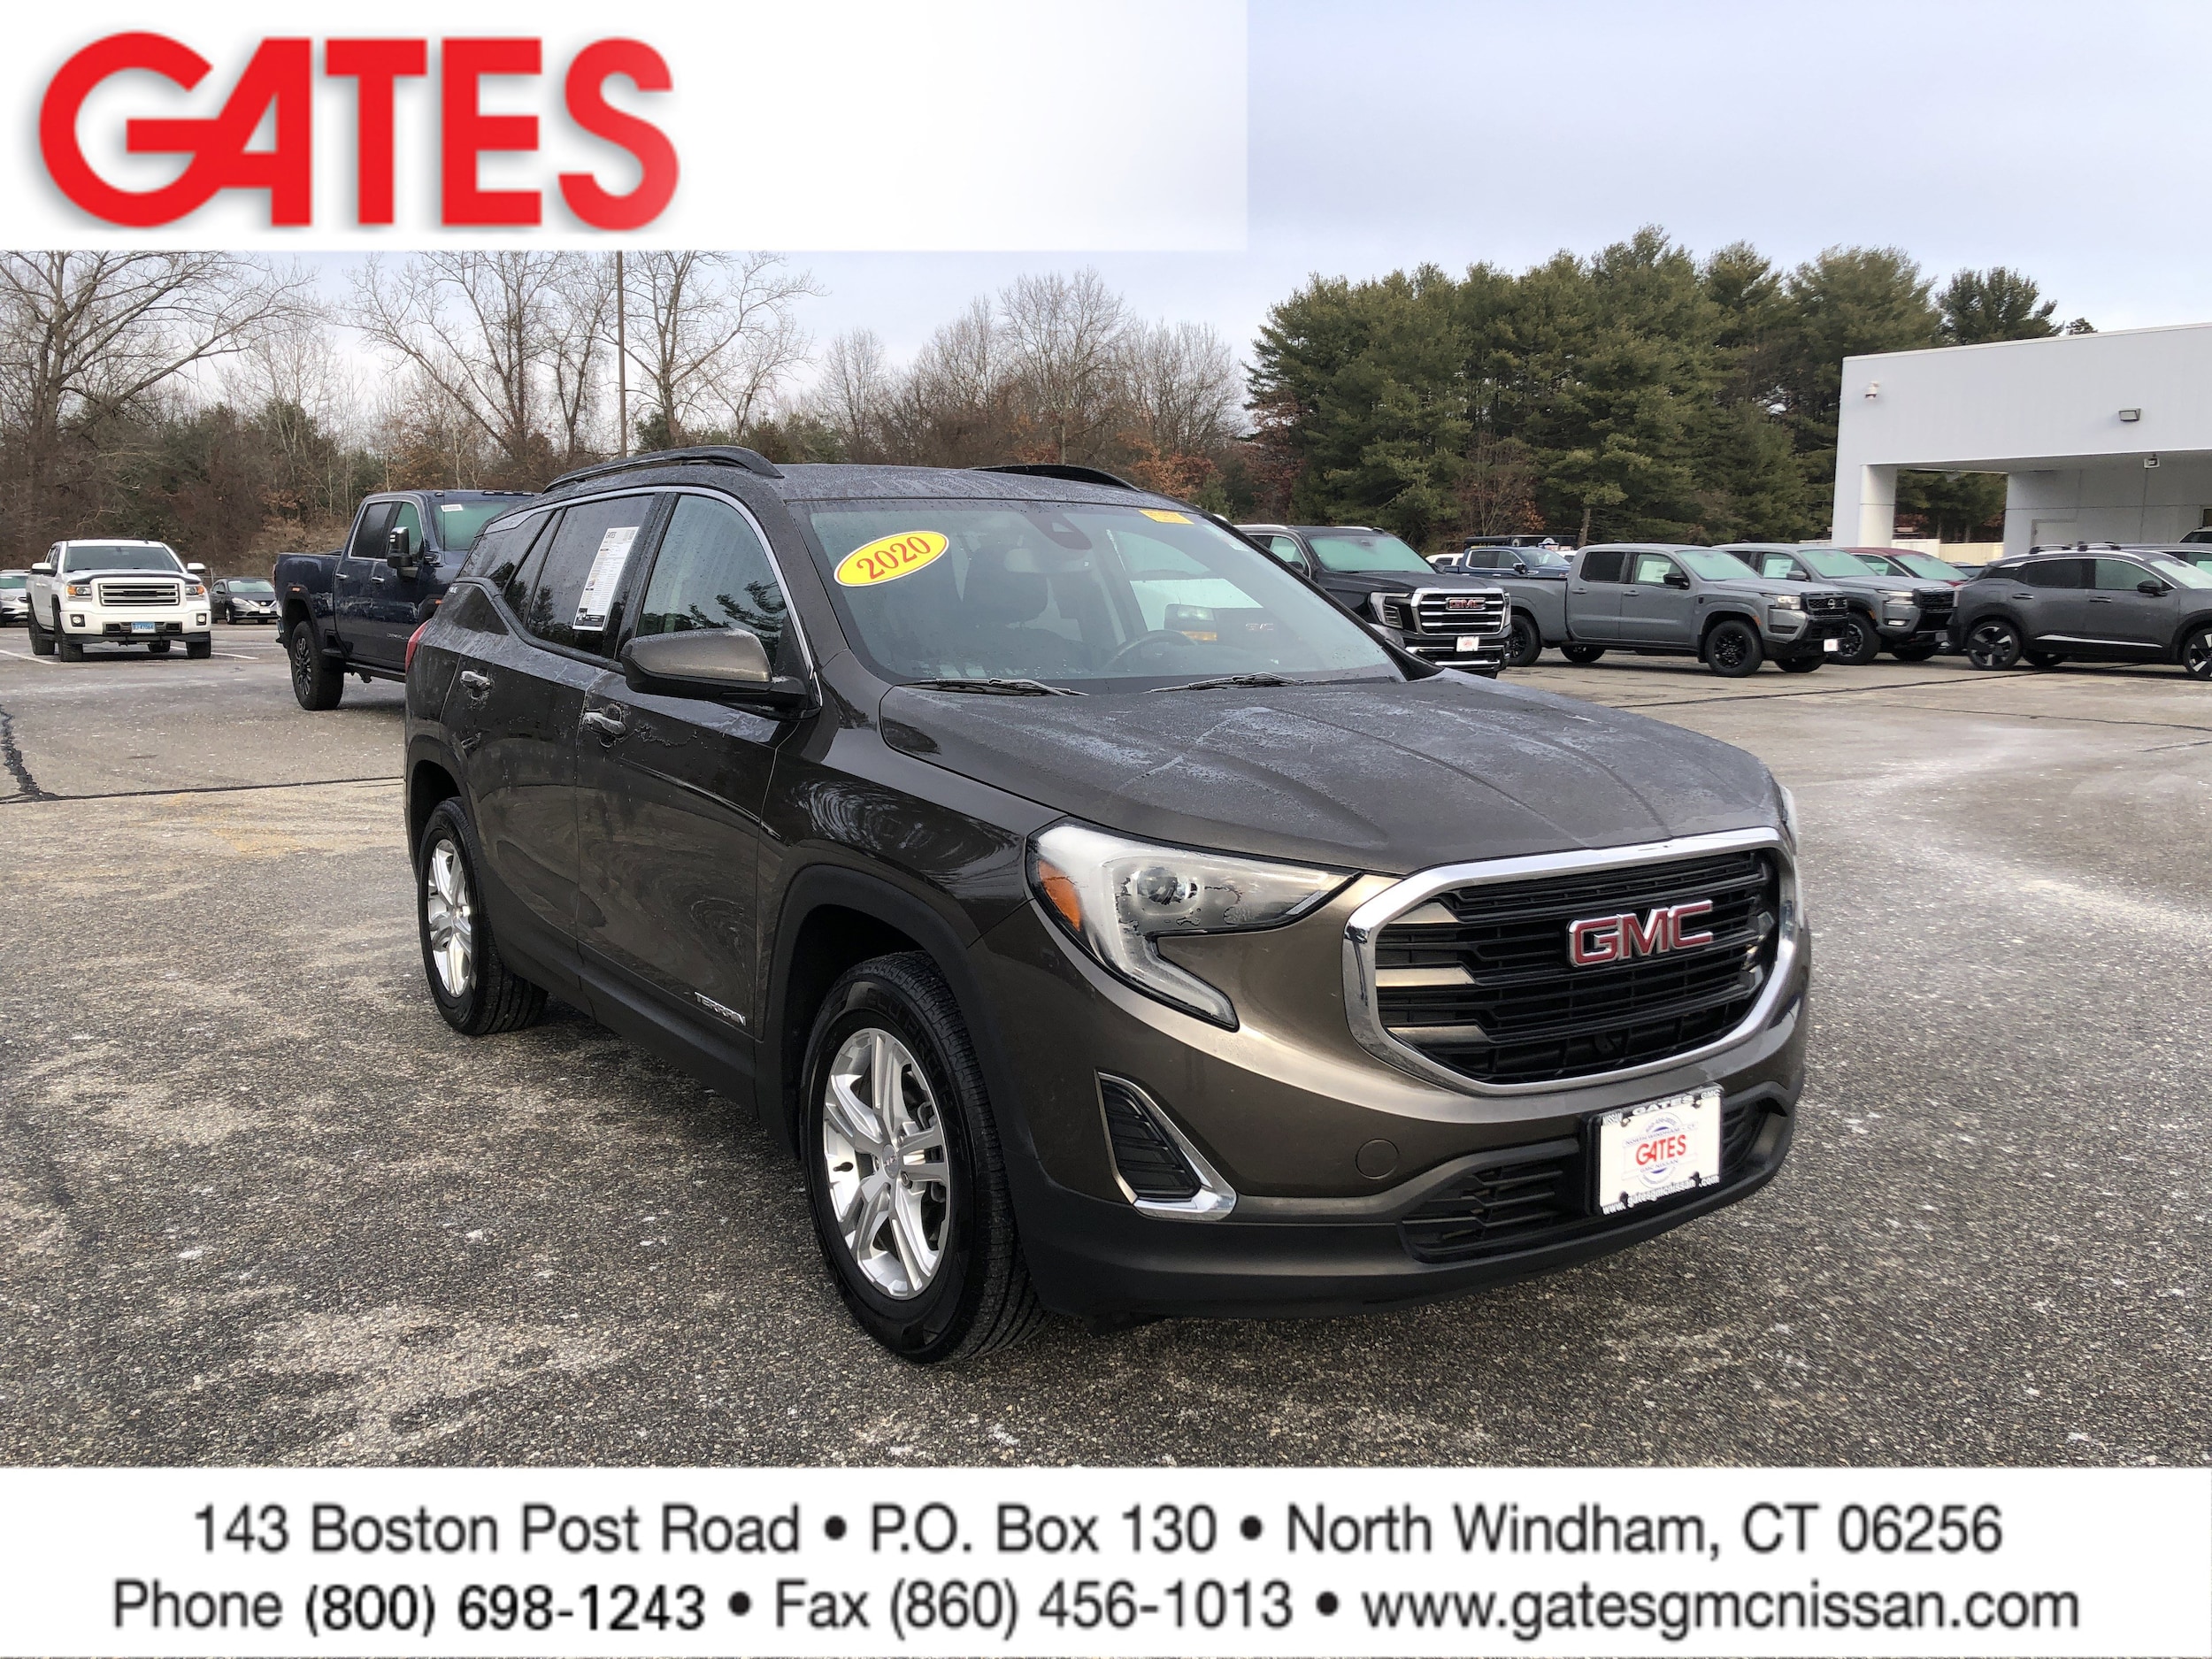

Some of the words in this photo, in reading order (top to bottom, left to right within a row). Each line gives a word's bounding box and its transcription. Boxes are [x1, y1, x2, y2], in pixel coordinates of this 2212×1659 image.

[856, 536, 932, 580] 2020
[1449, 599, 1486, 609] GMC
[1569, 899, 1714, 968] GMC
[1632, 1094, 1694, 1117] GATES
[1701, 1088, 1721, 1100] GMC
[1635, 1133, 1686, 1166] GATES
